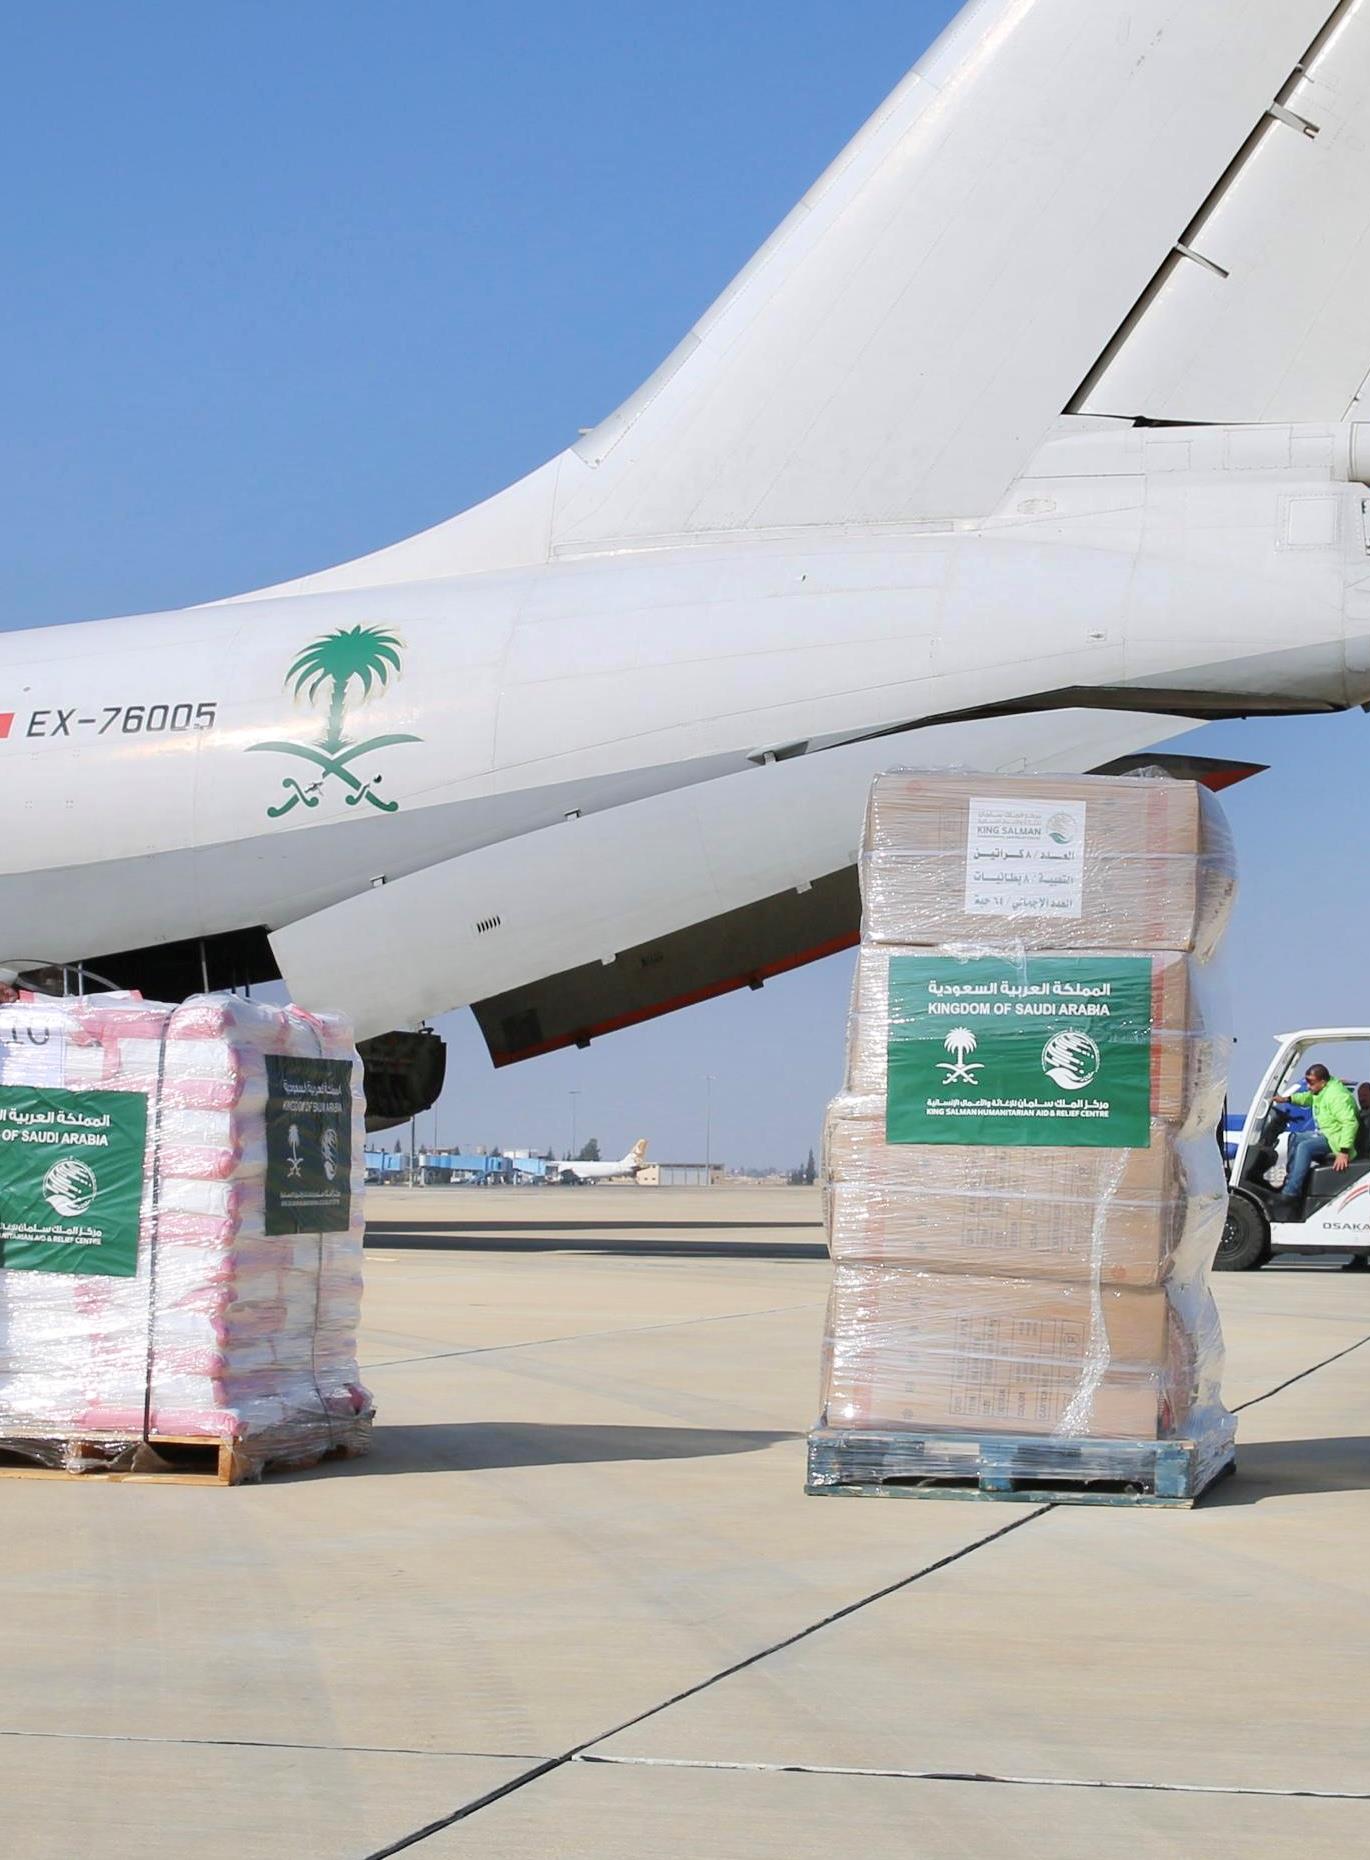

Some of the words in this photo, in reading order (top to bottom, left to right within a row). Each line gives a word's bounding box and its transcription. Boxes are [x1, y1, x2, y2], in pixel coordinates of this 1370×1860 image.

[26, 702, 218, 738] EX-76005
[977, 826, 999, 834] KING
[928, 980, 998, 997] السعودية
[1000, 980, 1050, 998] العربية
[1053, 980, 1111, 996] المملكة
[928, 1003, 991, 1014] KINGDOM
[993, 1003, 1012, 1014] OF
[1015, 1003, 1056, 1015] SAUDI
[1058, 1003, 1111, 1016] ARABIA
[9, 1107, 55, 1124] العربية
[57, 1110, 111, 1127] المملكة
[1080, 1109, 1110, 1117] CENTRE
[2, 1128, 19, 1141] OF
[21, 1130, 59, 1144] SAUDI
[61, 1132, 109, 1146] ARABIA
[1322, 1222, 1370, 1230] OSAKA
[53, 1235, 75, 1244] RELIEF
[75, 1237, 102, 1245] CENTRE
